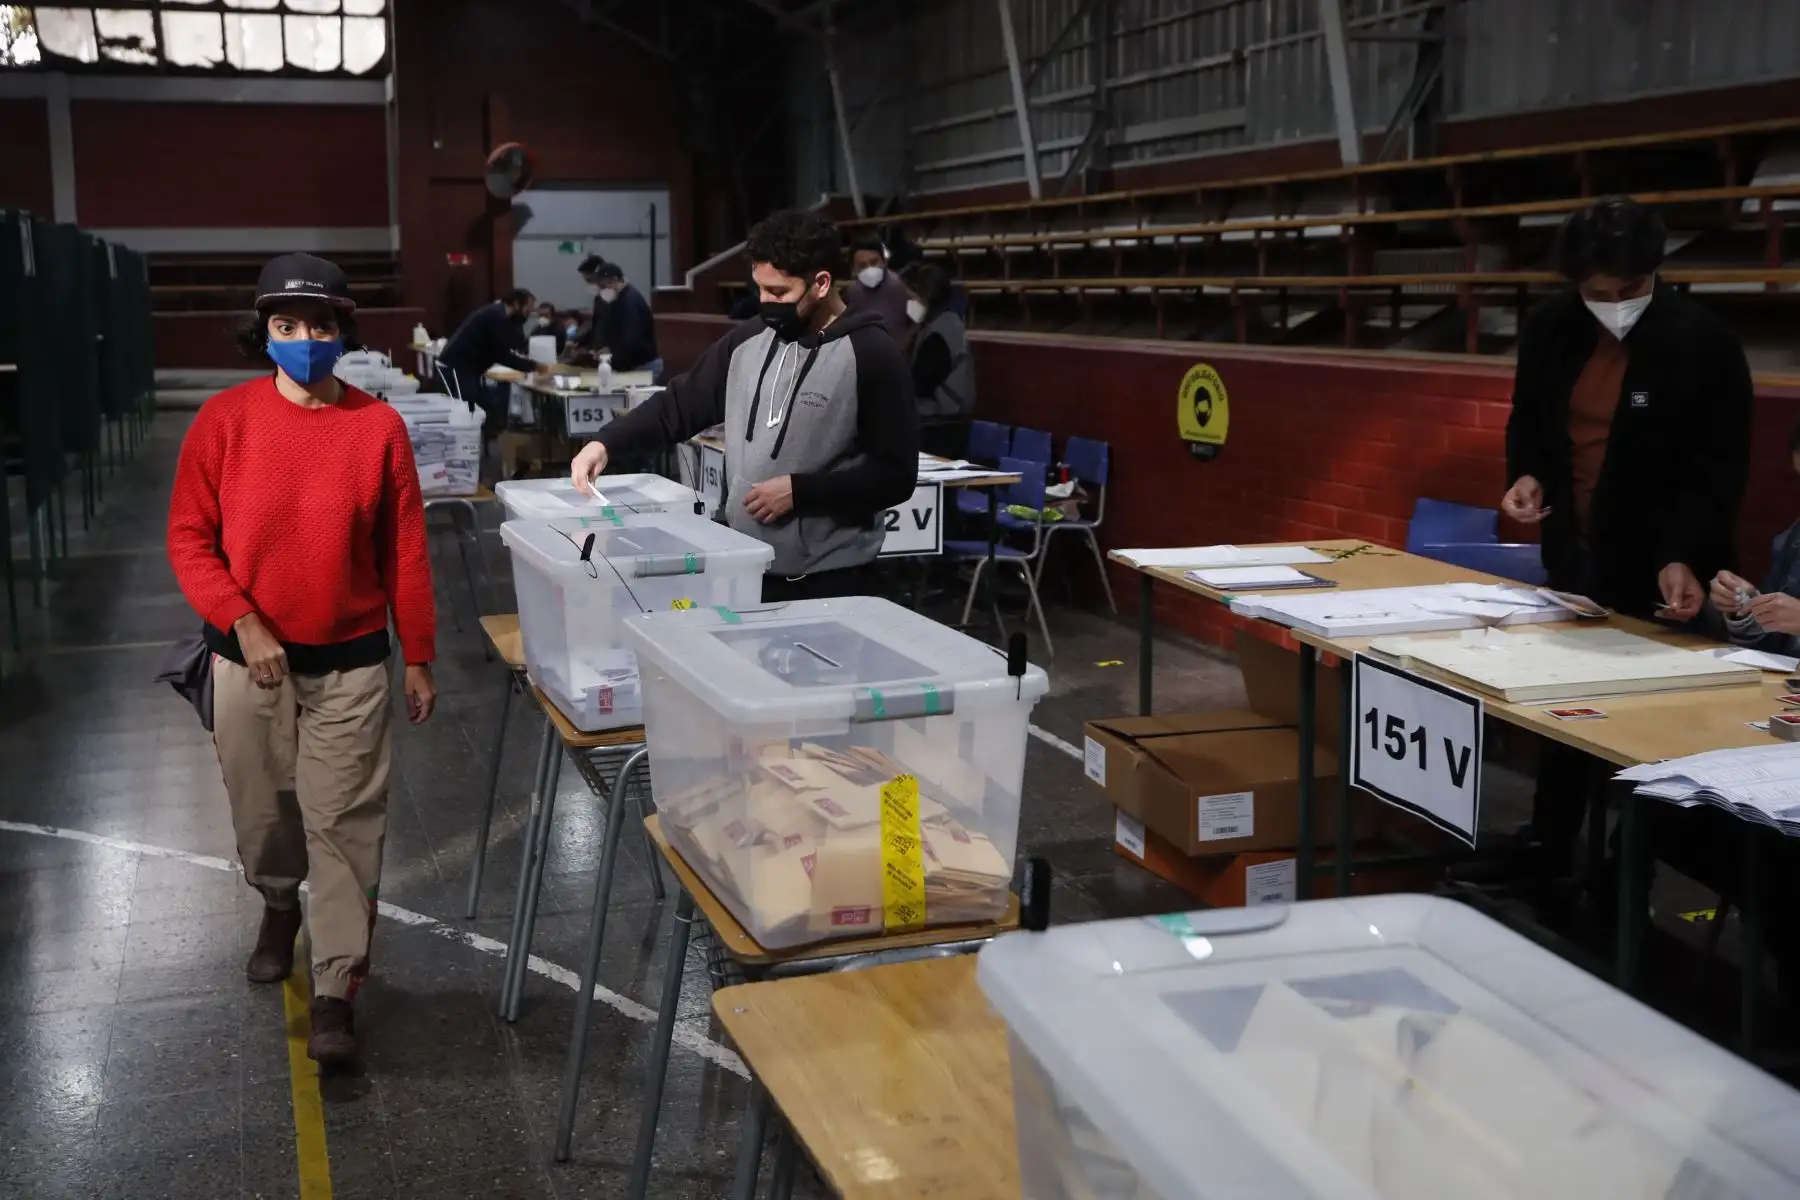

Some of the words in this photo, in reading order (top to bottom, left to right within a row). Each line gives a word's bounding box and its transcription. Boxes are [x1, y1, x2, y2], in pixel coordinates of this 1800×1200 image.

[572, 408, 604, 422] 153
[884, 509, 900, 531] 2
[911, 508, 933, 530] V
[1365, 706, 1427, 771] 151
[1443, 736, 1472, 789] V
